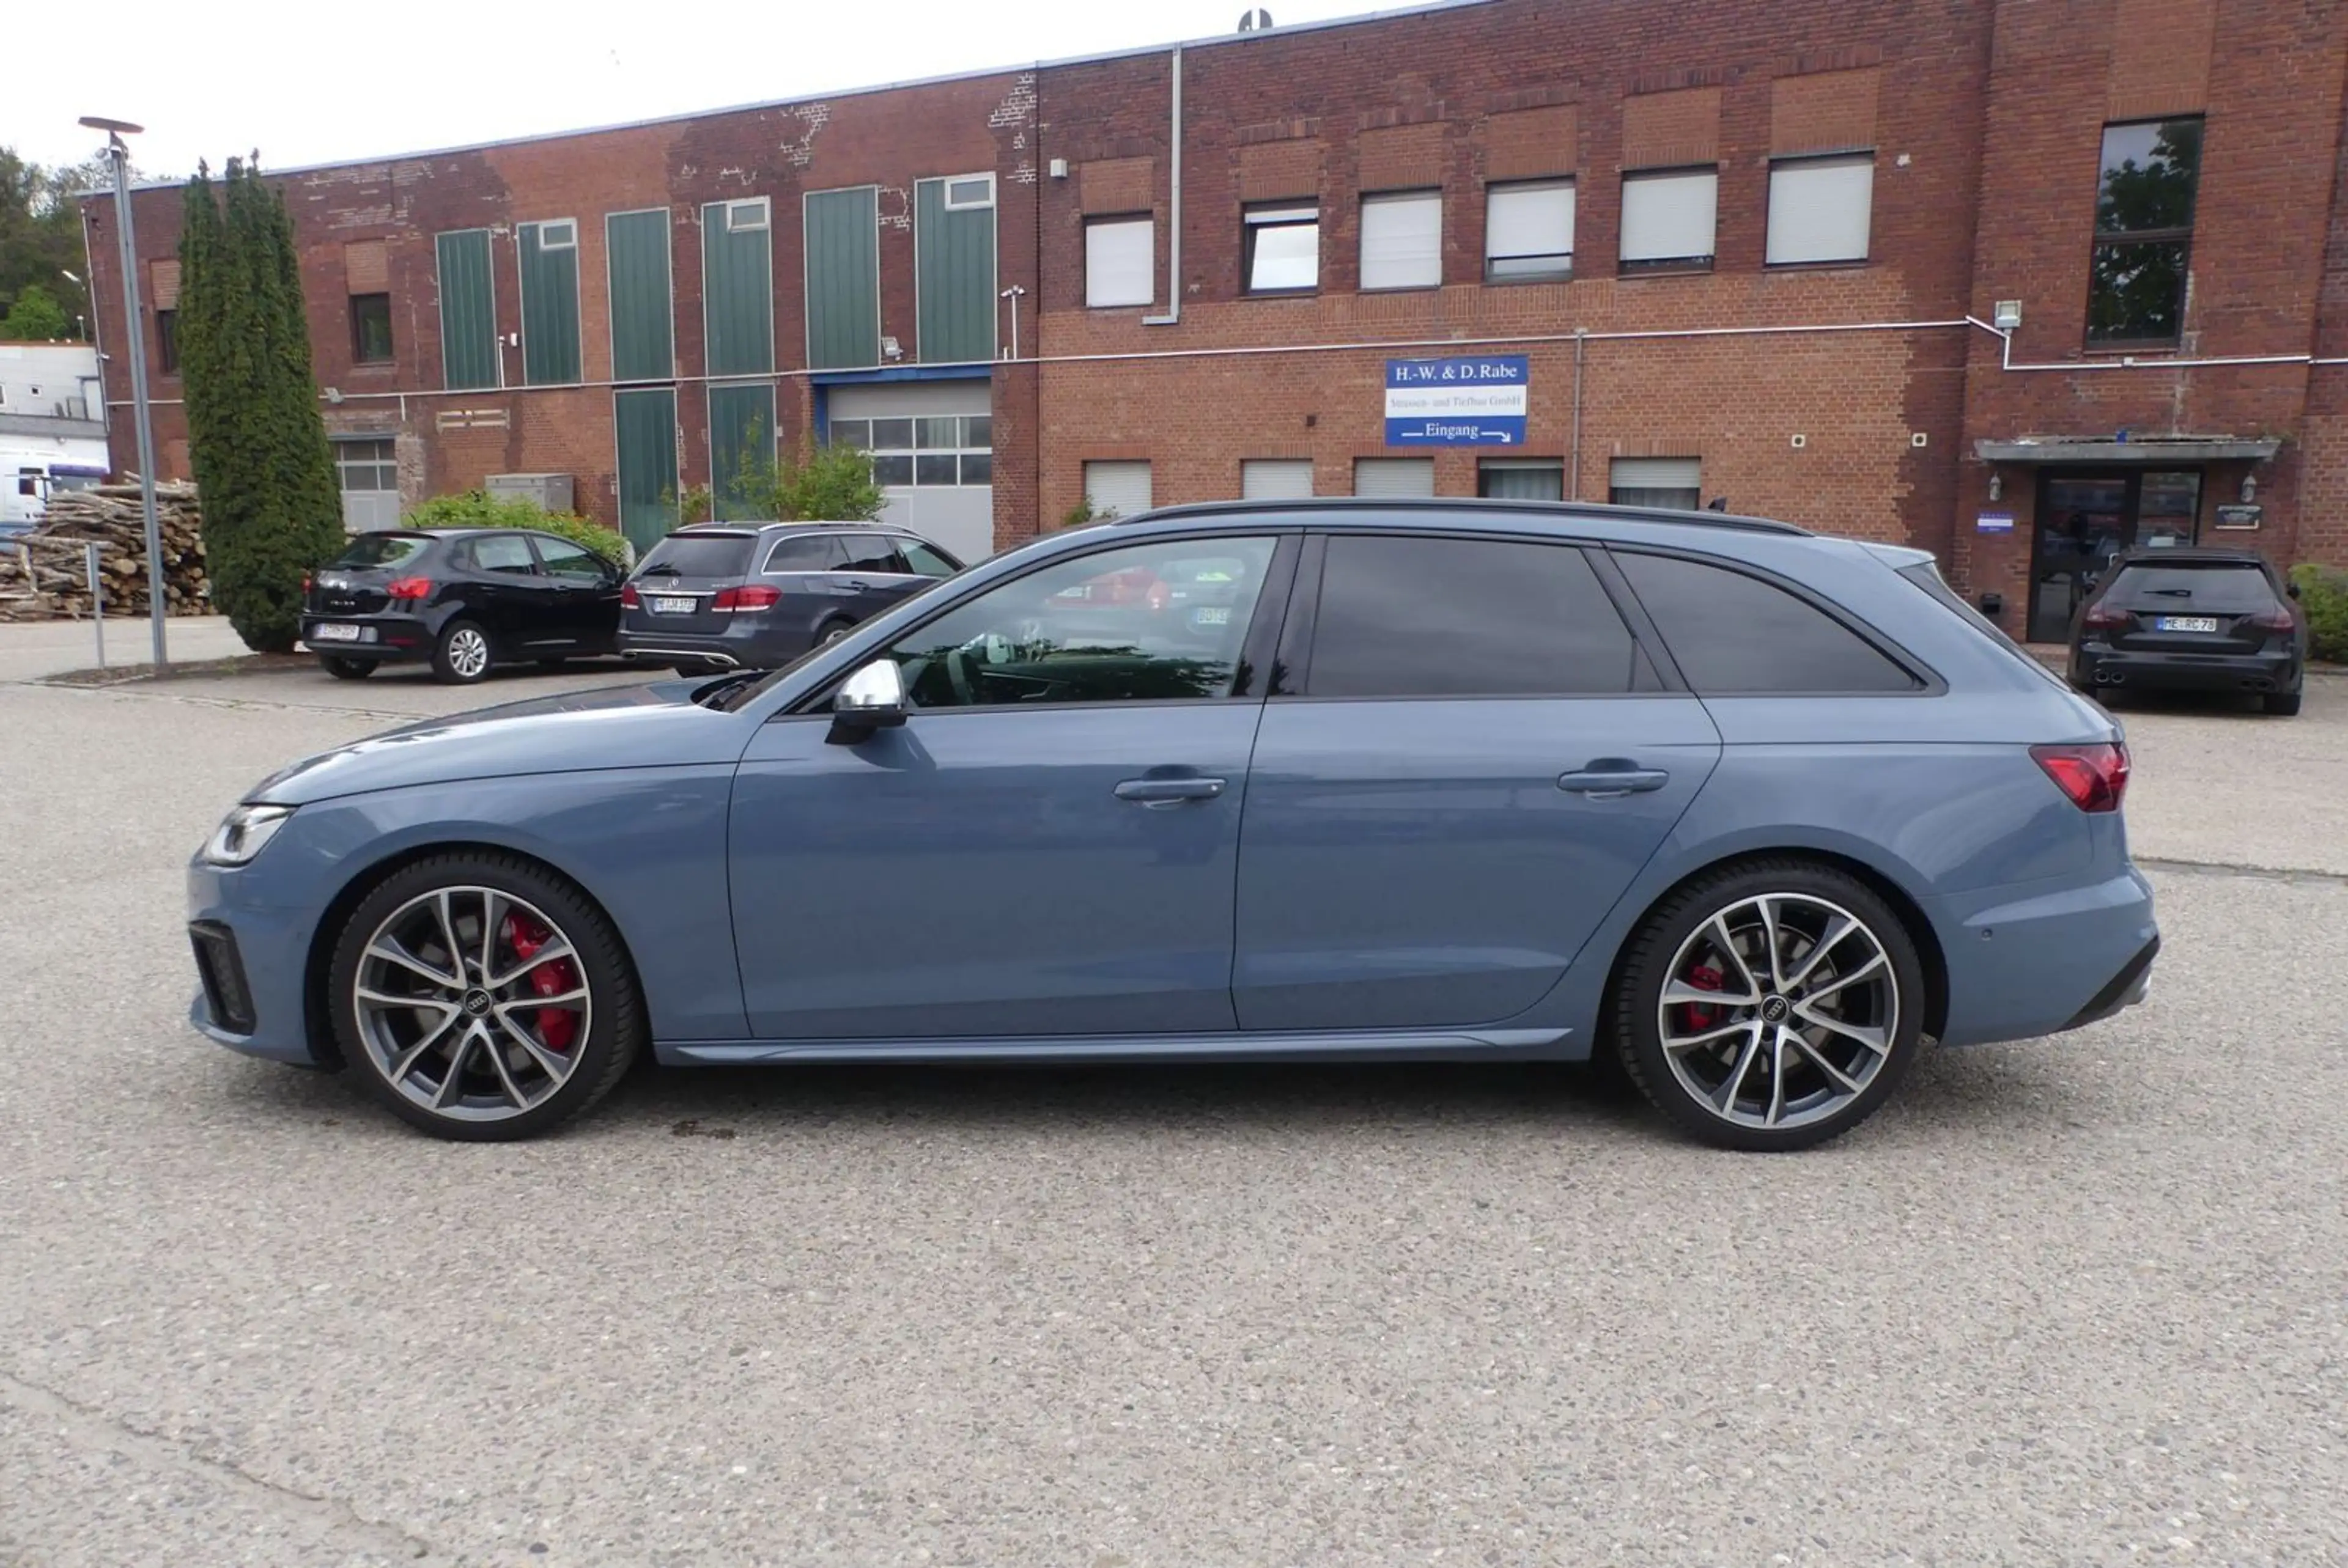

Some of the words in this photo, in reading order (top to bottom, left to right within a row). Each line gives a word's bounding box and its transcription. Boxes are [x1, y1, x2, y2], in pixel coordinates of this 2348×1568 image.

[1442, 364, 1456, 380] &
[1460, 364, 1477, 379] D.
[1480, 363, 1518, 378] Rabe
[1425, 422, 1479, 440] Eingang
